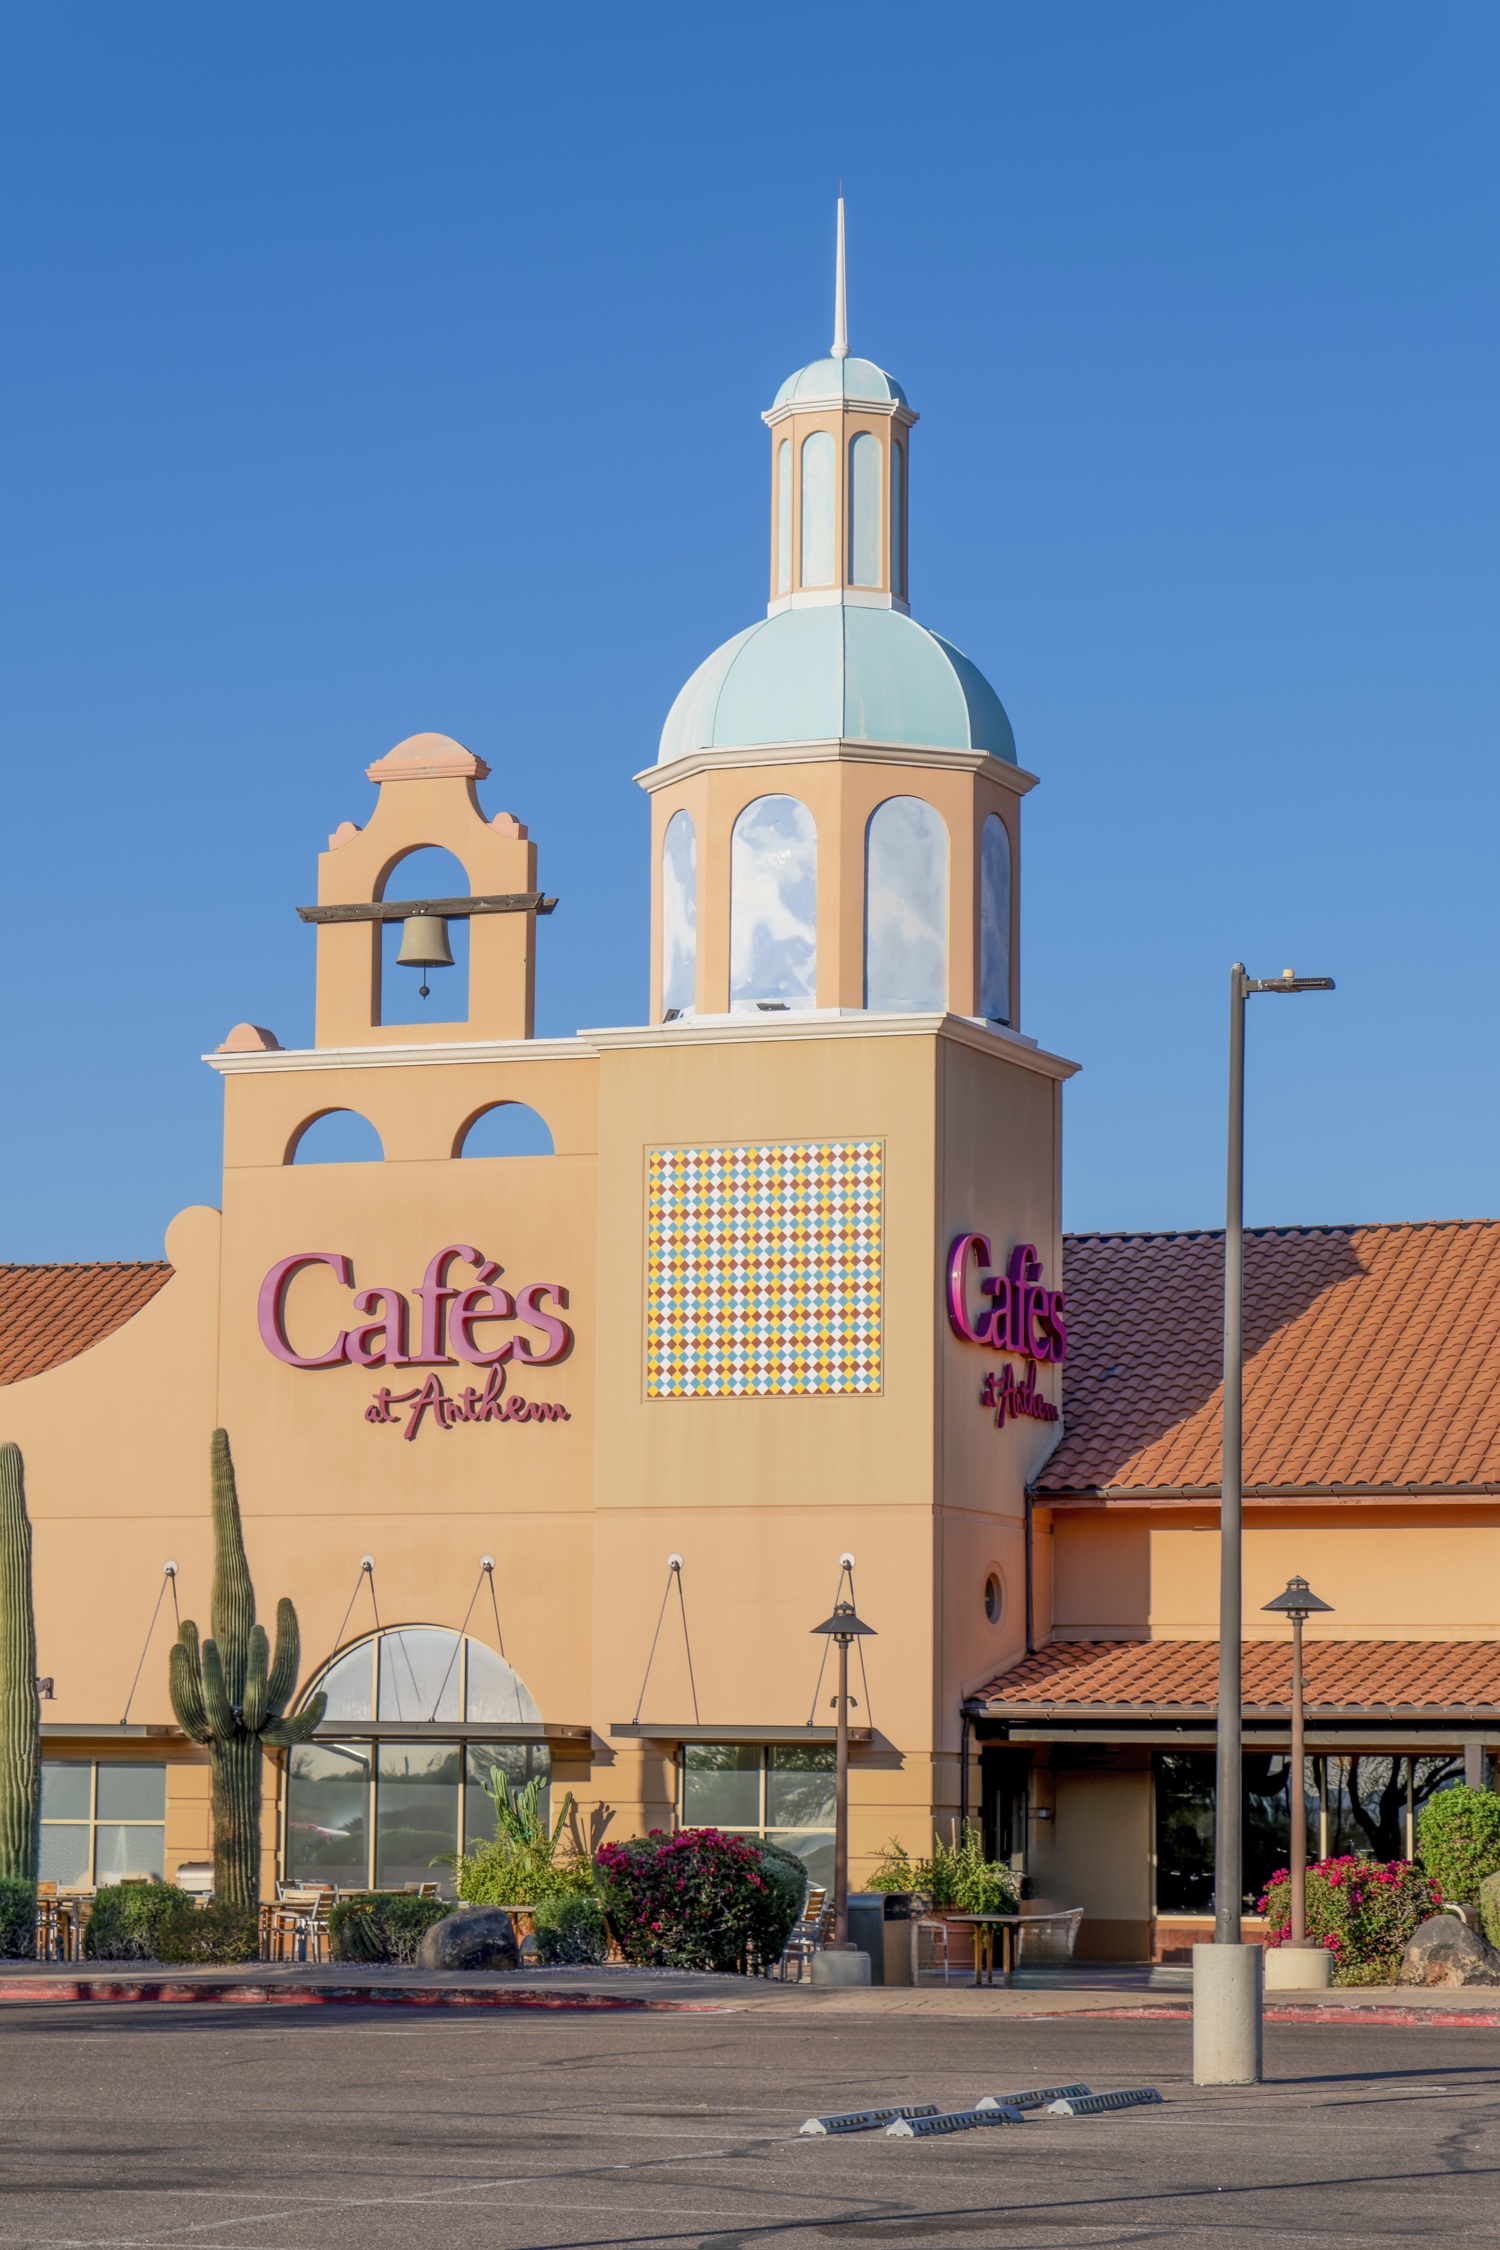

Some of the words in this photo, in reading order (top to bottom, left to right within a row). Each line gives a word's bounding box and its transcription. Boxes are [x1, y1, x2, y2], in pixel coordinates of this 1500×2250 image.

[257, 1243, 573, 1367] Cafés
[948, 1232, 1067, 1363] Cafés
[364, 1387, 421, 1423] at
[403, 1363, 570, 1441] Anthem
[982, 1371, 1006, 1408] at
[996, 1359, 1060, 1428] Anthem
